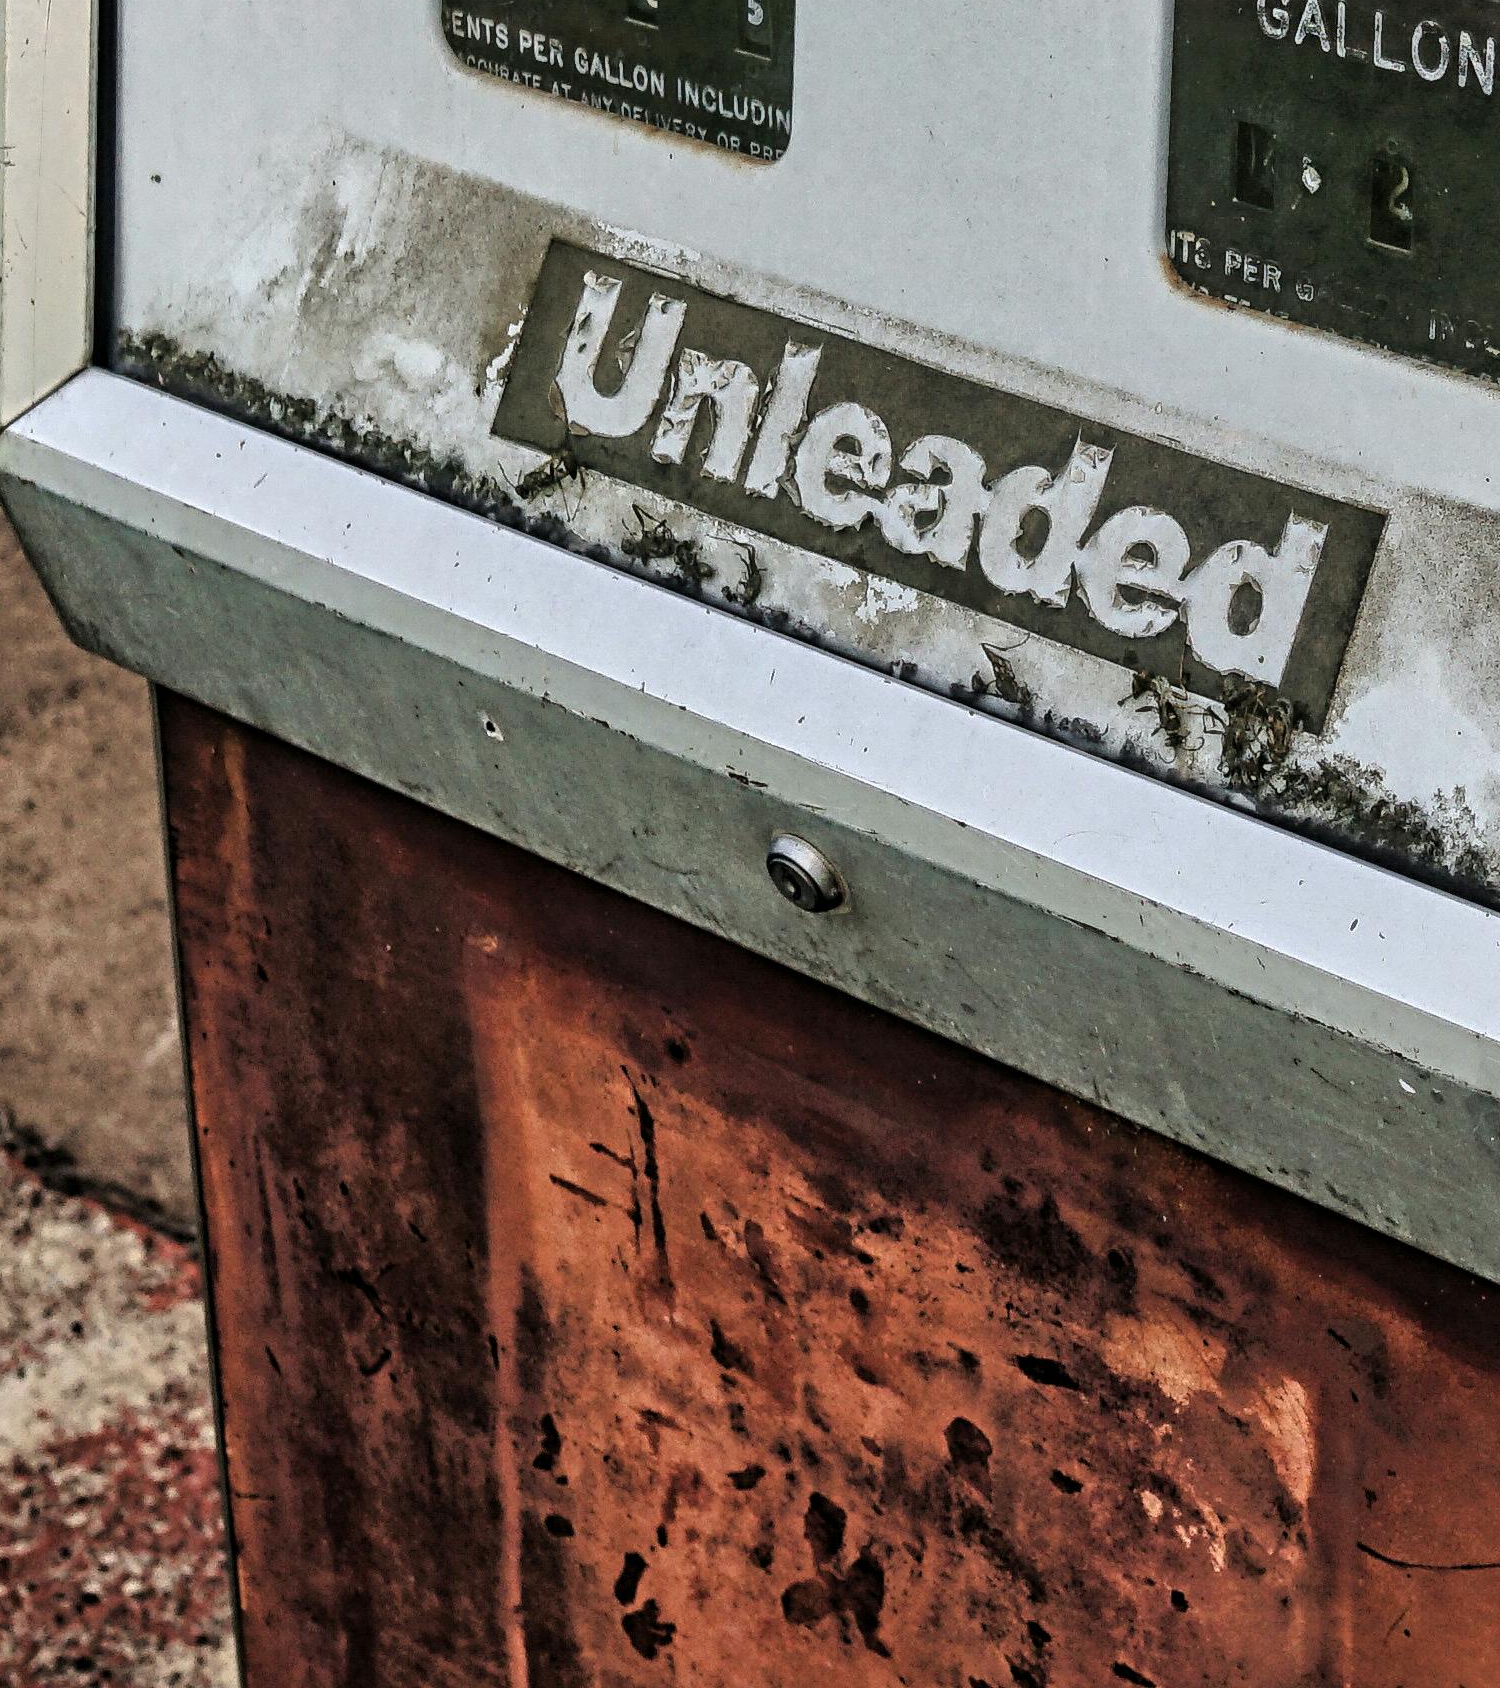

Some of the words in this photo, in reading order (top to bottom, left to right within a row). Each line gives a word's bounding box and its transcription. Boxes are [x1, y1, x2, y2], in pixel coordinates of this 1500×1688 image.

[445, 9, 509, 50] ENTS
[518, 28, 564, 69] PER
[574, 46, 666, 99] GALLON
[677, 77, 791, 136] INCLUDIN
[1224, 247, 1282, 294] PER
[553, 270, 1336, 687] Unleaded
